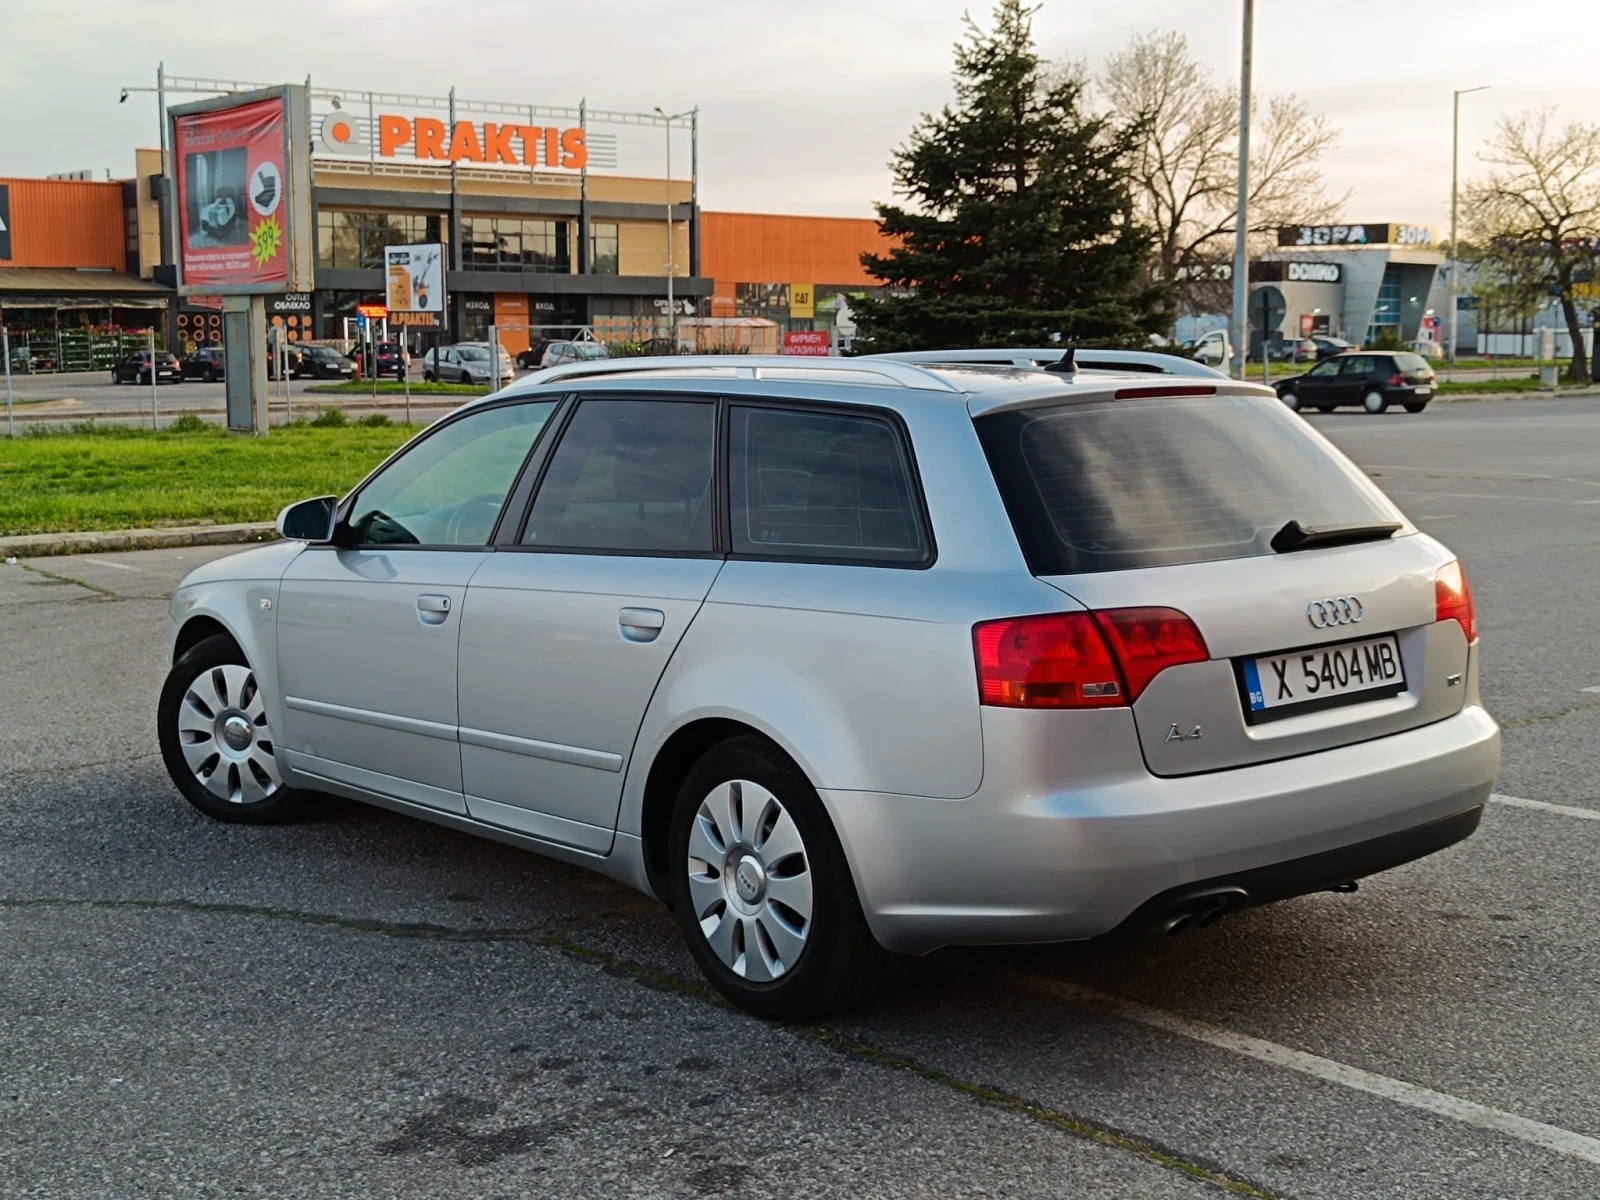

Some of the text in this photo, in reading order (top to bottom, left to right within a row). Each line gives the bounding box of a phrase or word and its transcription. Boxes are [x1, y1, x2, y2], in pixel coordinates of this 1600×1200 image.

[379, 115, 588, 169] PRAKTIS
[285, 293, 310, 301] OUTLET
[794, 292, 809, 304] CAT
[274, 301, 311, 310] ОБЛЕКЛО
[465, 301, 491, 310] ИЗХОД
[535, 302, 555, 311] ВХОД
[790, 334, 822, 344] ФИРМЕН
[1272, 643, 1396, 699] X 5404 MB
[1250, 691, 1263, 704] BG
[1164, 723, 1203, 743] A4
